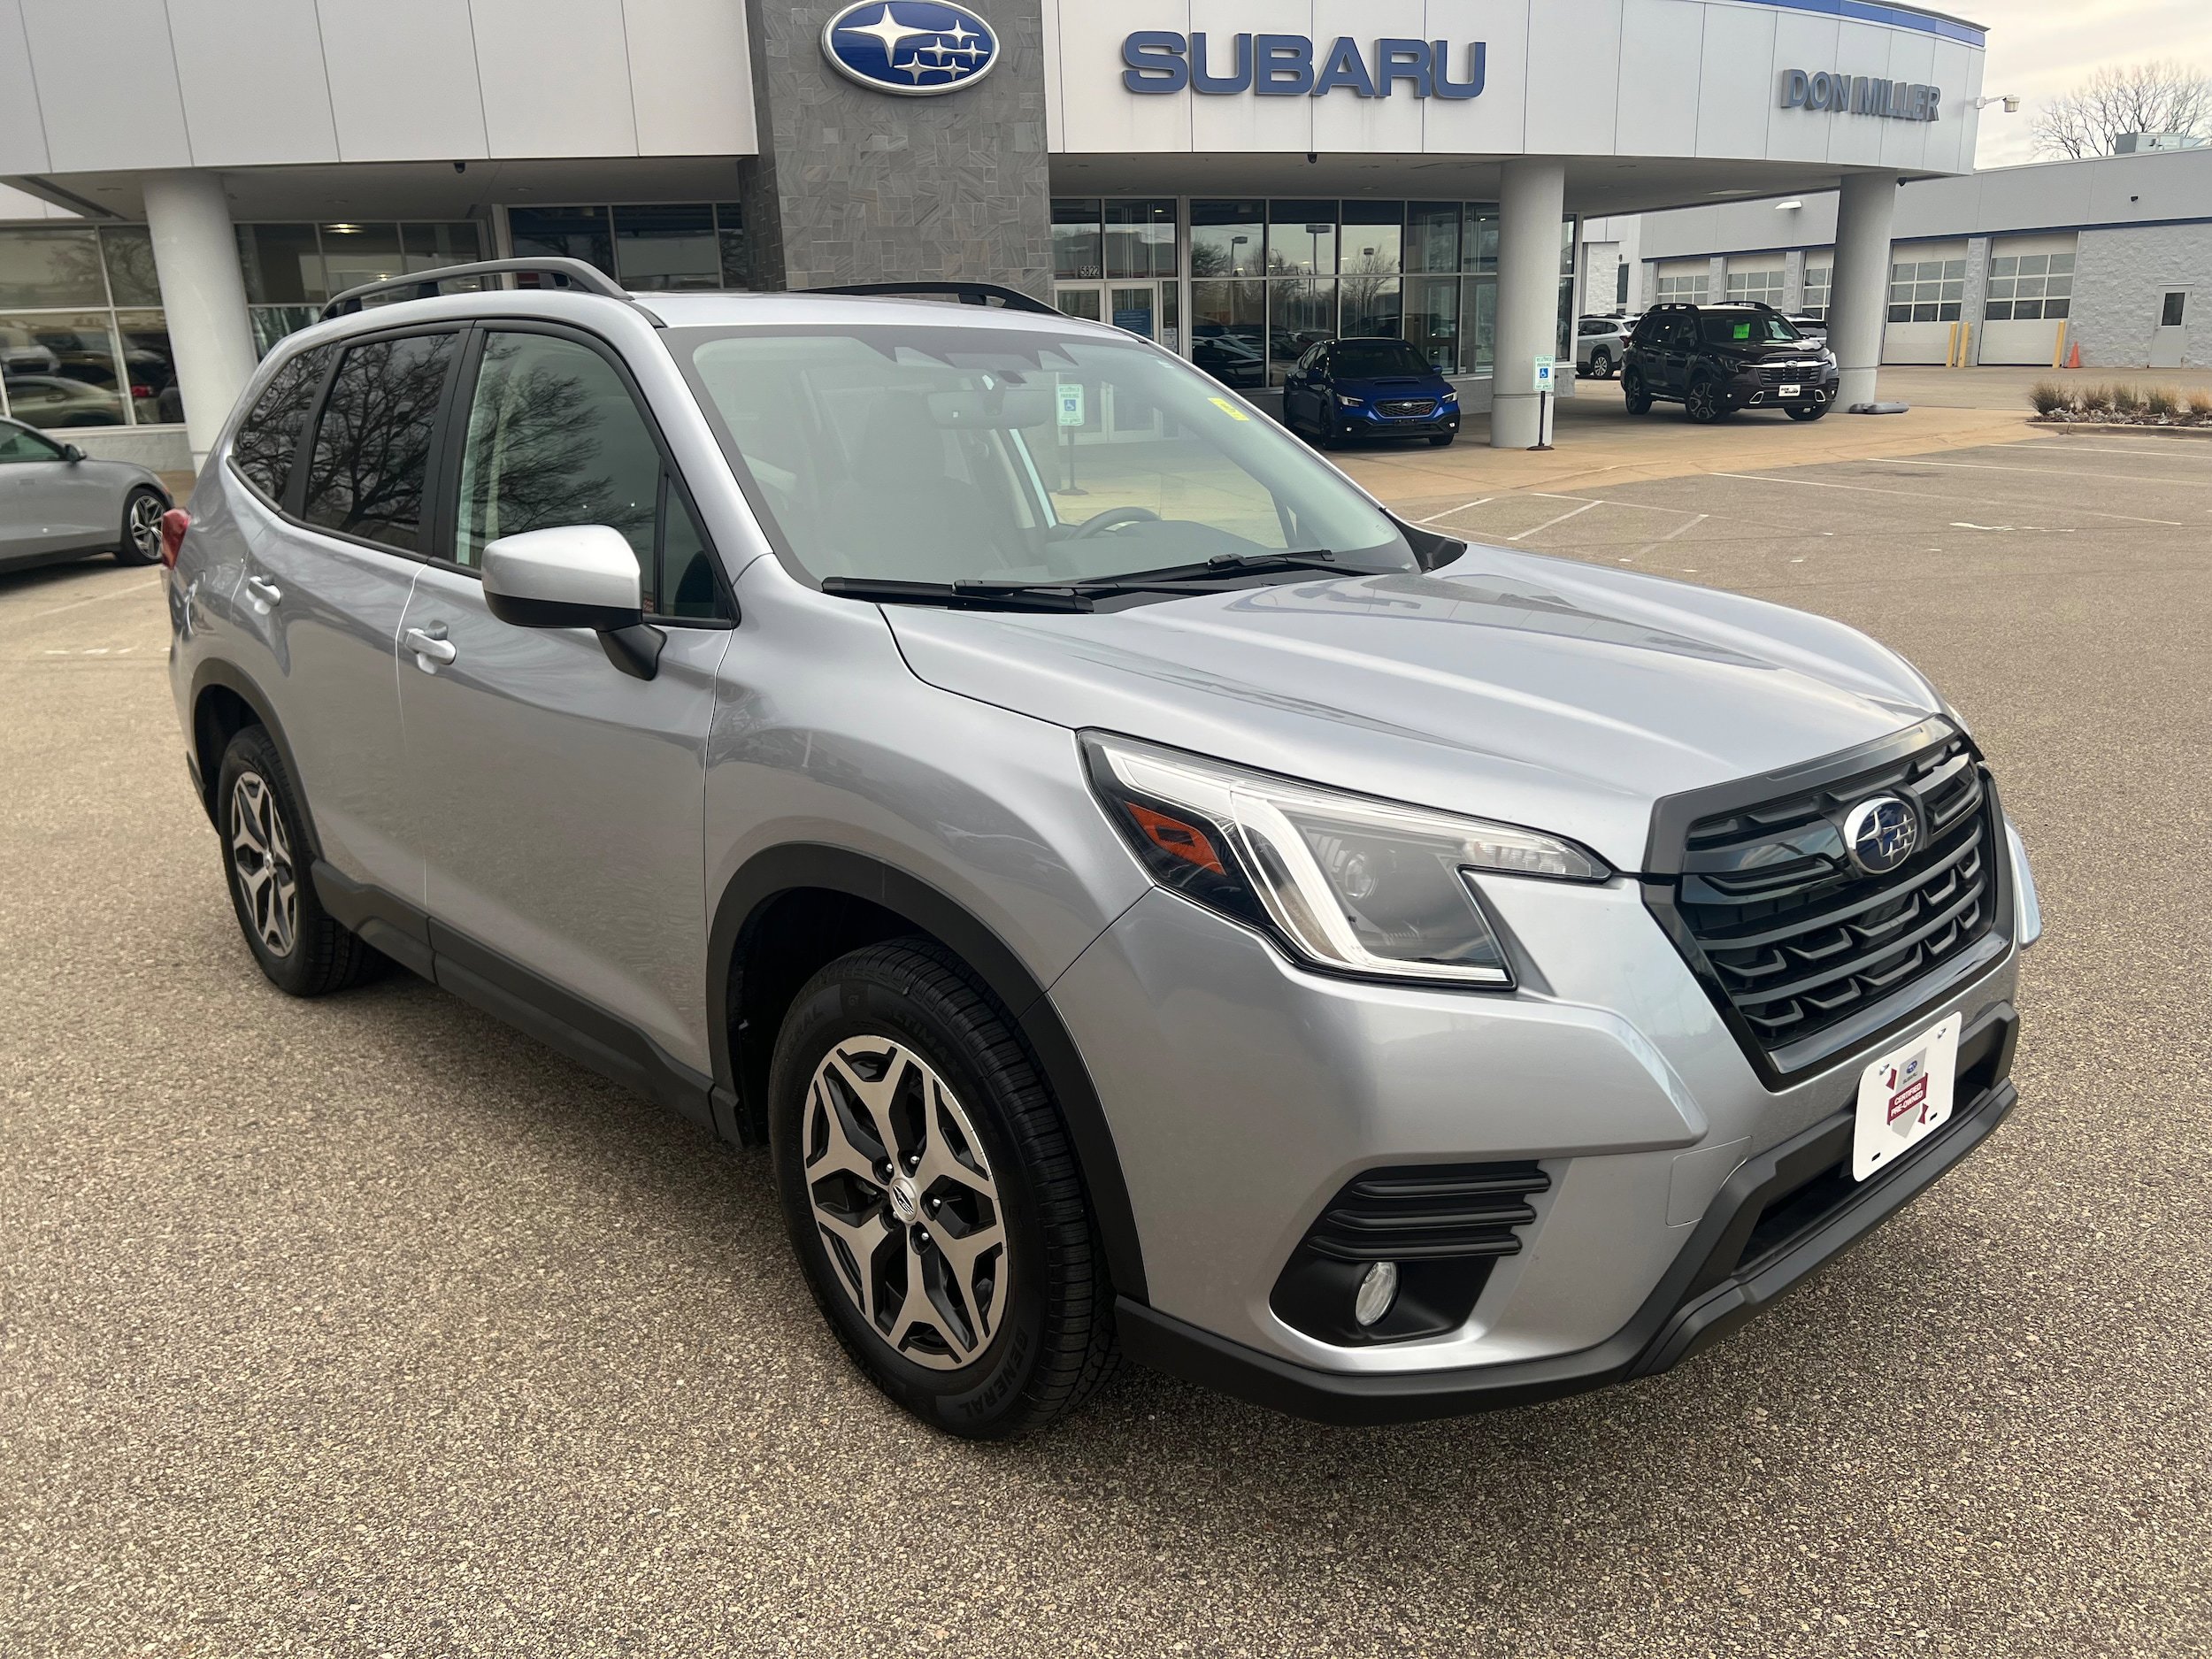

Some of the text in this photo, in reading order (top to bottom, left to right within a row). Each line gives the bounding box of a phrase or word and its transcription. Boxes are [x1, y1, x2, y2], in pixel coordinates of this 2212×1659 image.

[1122, 30, 1486, 99] SUBARU
[1781, 69, 1941, 122] DON MILLER
[1080, 265, 1099, 276] 5822
[1891, 1090, 1924, 1117] PRE-OWNED
[1894, 1083, 1922, 1105] CERTIFIED
[958, 1326, 1028, 1417] GENERAL
